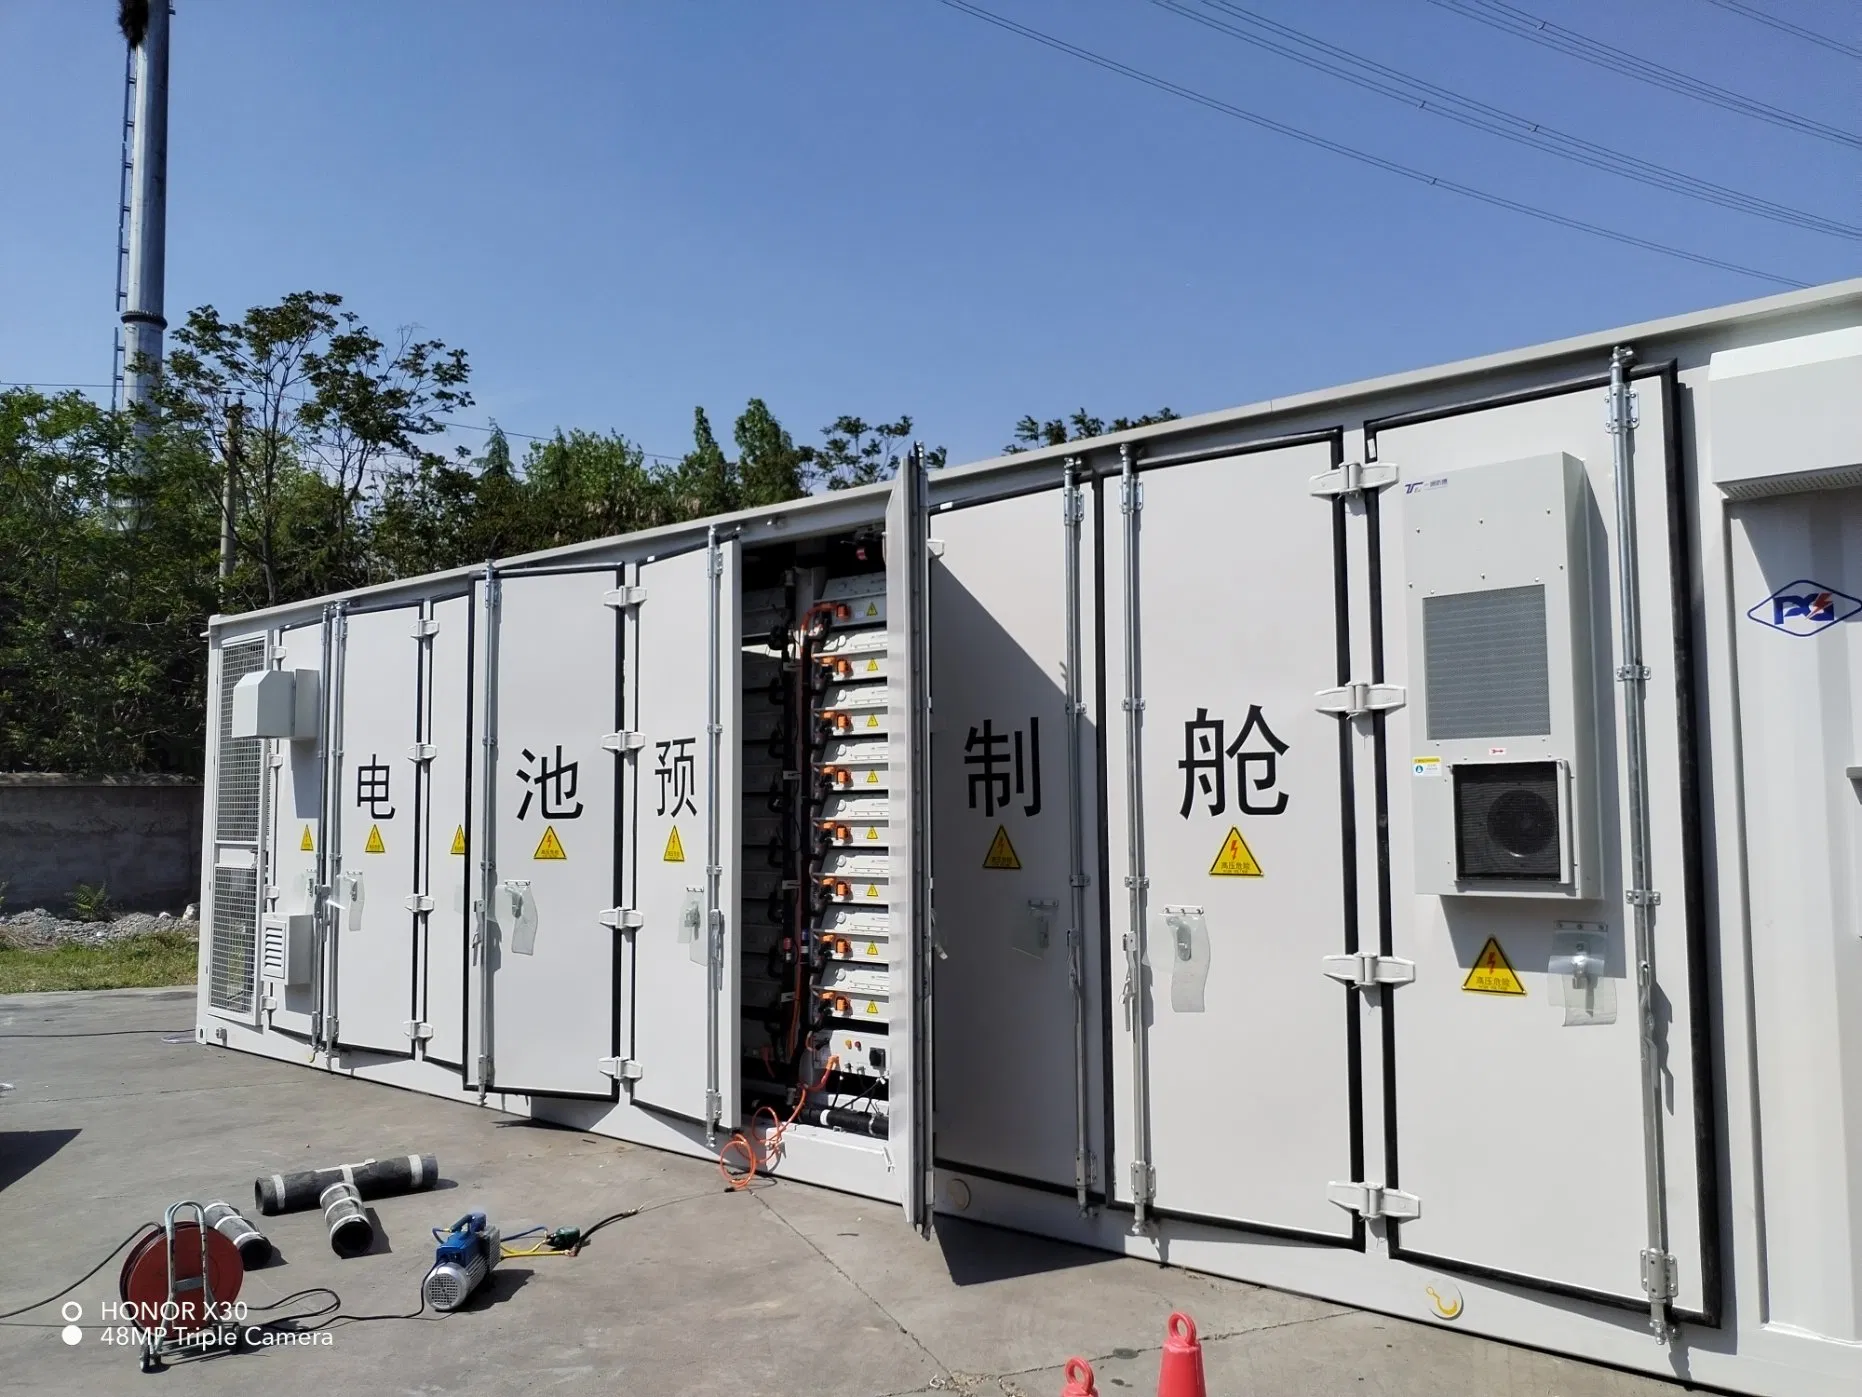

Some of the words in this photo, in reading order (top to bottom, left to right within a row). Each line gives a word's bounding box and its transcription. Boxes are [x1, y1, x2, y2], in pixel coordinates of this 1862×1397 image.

[356, 753, 396, 820] 电
[516, 745, 584, 821] 池
[654, 737, 698, 818] 预
[964, 717, 1041, 817] 制
[1178, 704, 1290, 820] 舱
